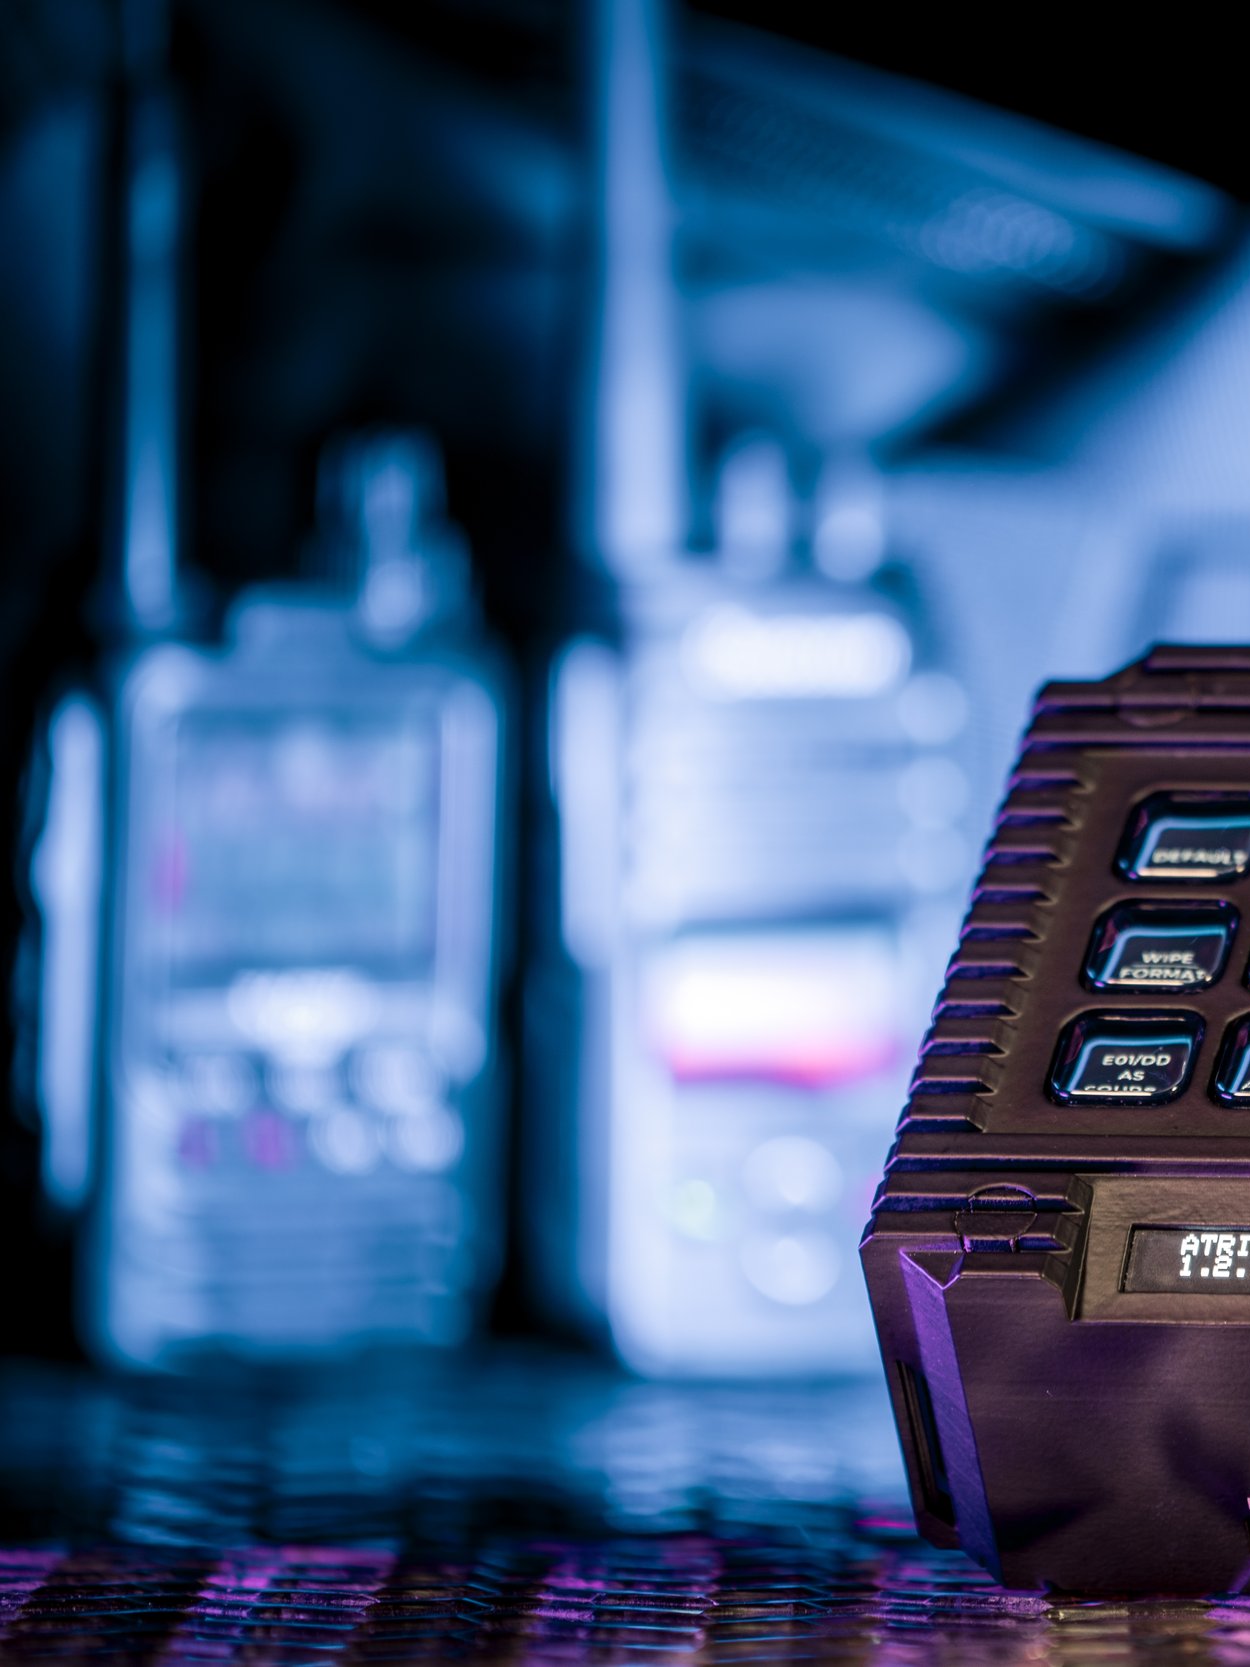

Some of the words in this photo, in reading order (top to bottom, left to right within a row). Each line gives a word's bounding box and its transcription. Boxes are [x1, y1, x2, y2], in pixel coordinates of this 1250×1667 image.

[1153, 849, 1247, 864] DEFAULT
[1143, 951, 1193, 964] WIPE
[1120, 968, 1206, 980] FORMAT
[1118, 1070, 1144, 1081] AS
